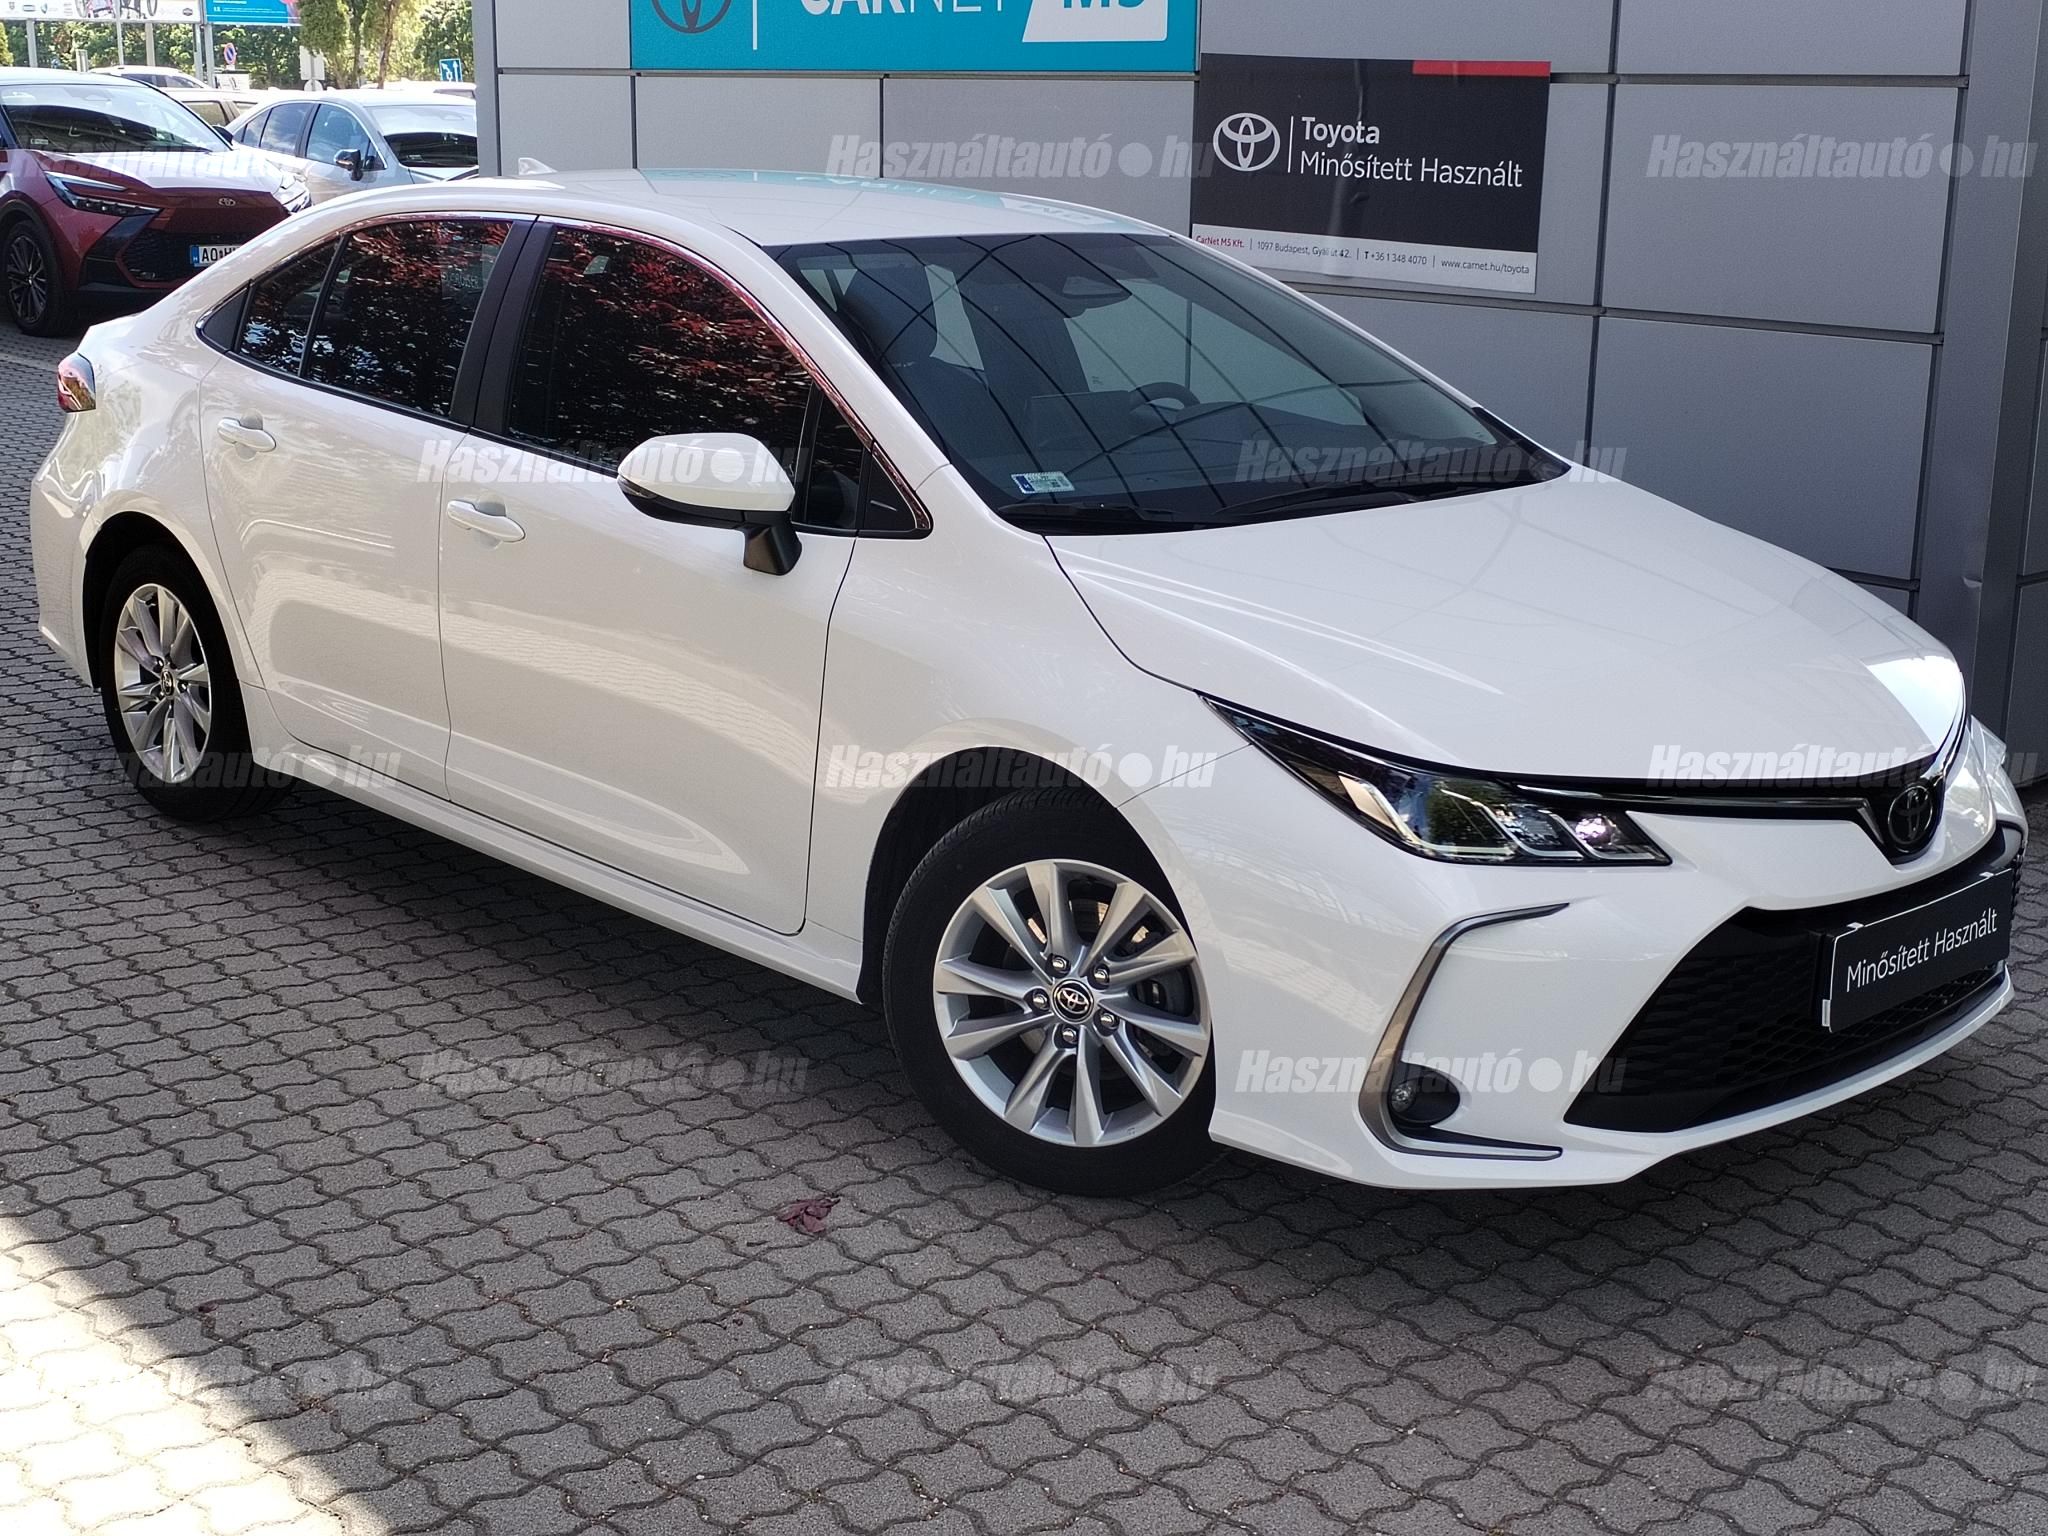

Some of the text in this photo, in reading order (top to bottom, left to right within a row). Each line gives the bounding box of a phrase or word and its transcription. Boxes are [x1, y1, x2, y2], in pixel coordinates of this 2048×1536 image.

[1302, 116, 1380, 148] Toyota
[1300, 150, 1523, 188] Minősített Használt
[1196, 235, 1220, 247] CarNet
[1220, 237, 1232, 247] M5
[1257, 240, 1274, 251] 1097
[1274, 243, 1311, 256] Budapest,
[1391, 253, 1407, 264] 348
[1407, 255, 1428, 266] 4070
[1441, 258, 1531, 275] www.carnet.hu/toyota
[1846, 907, 1998, 993] Minősített Használt
